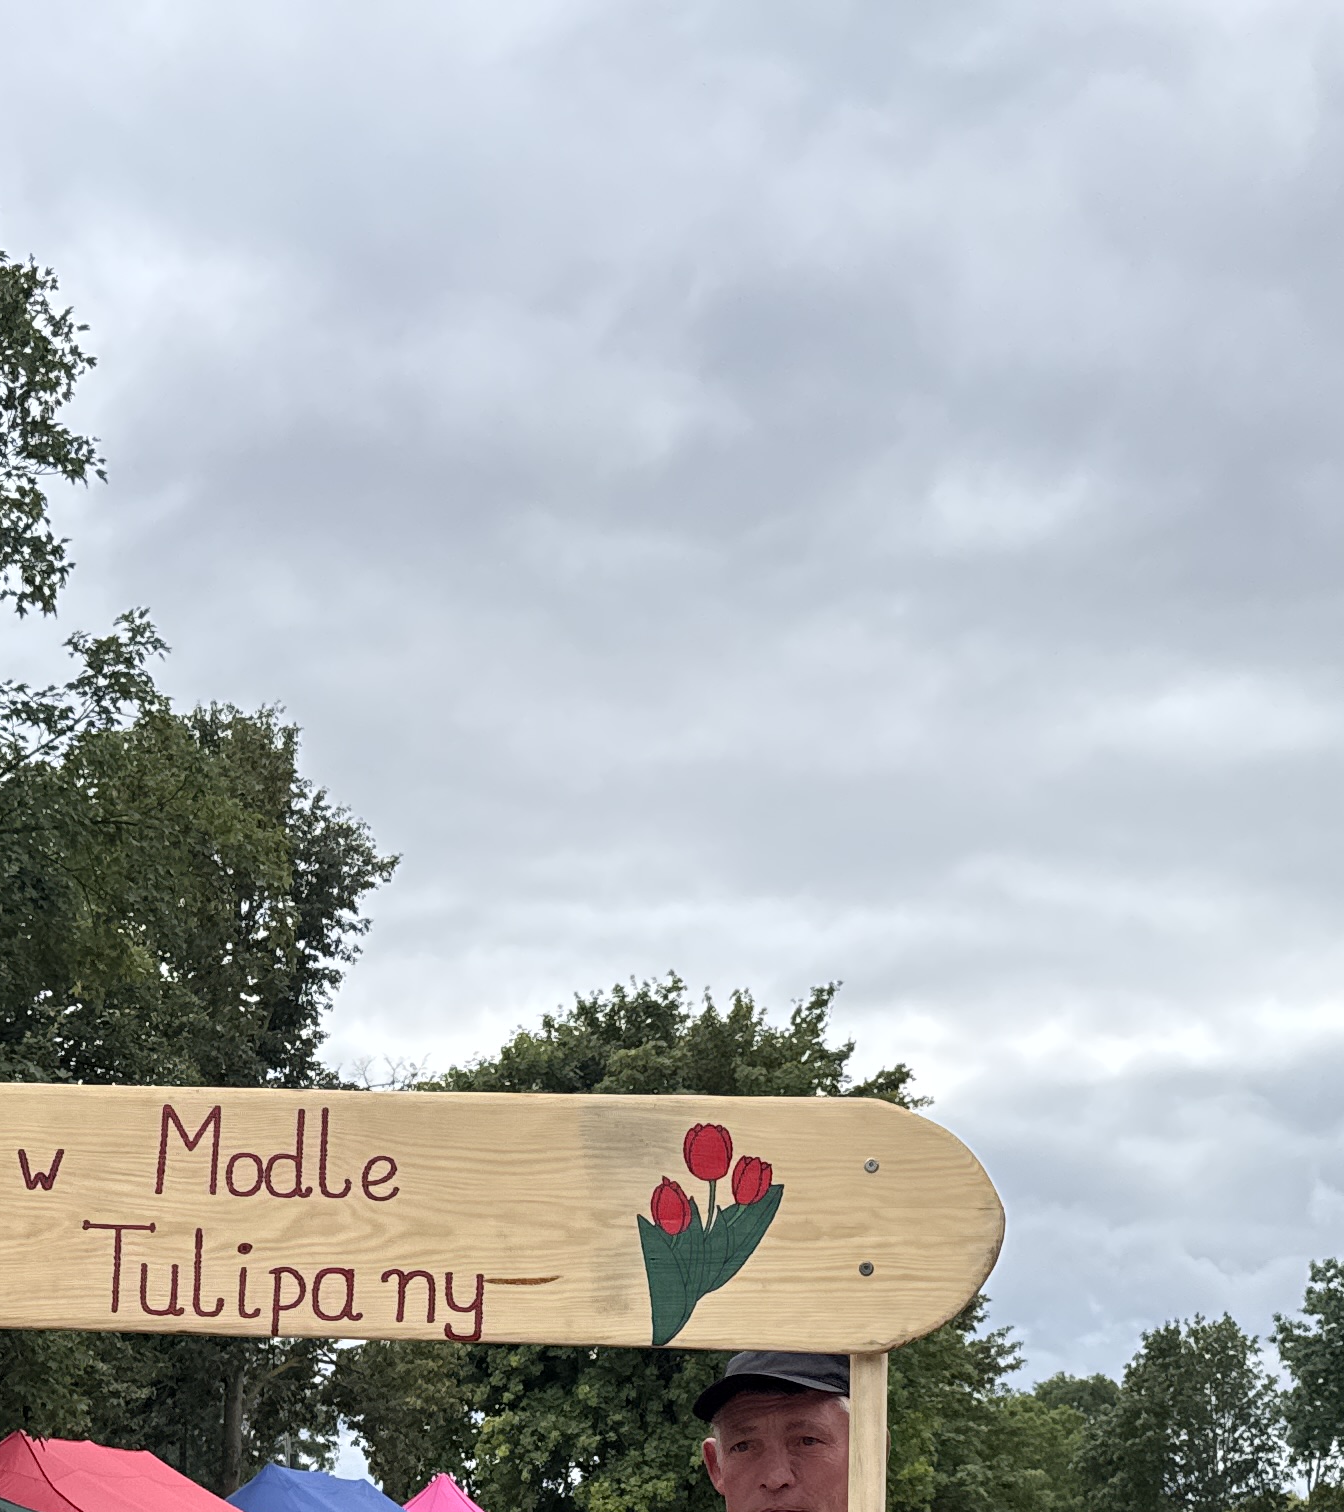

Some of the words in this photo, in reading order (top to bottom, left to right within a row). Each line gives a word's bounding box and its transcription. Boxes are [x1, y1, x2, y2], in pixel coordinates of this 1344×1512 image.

[18, 1147, 66, 1192] w
[155, 1103, 400, 1201] Modle
[82, 1219, 487, 1343] Tulipany
